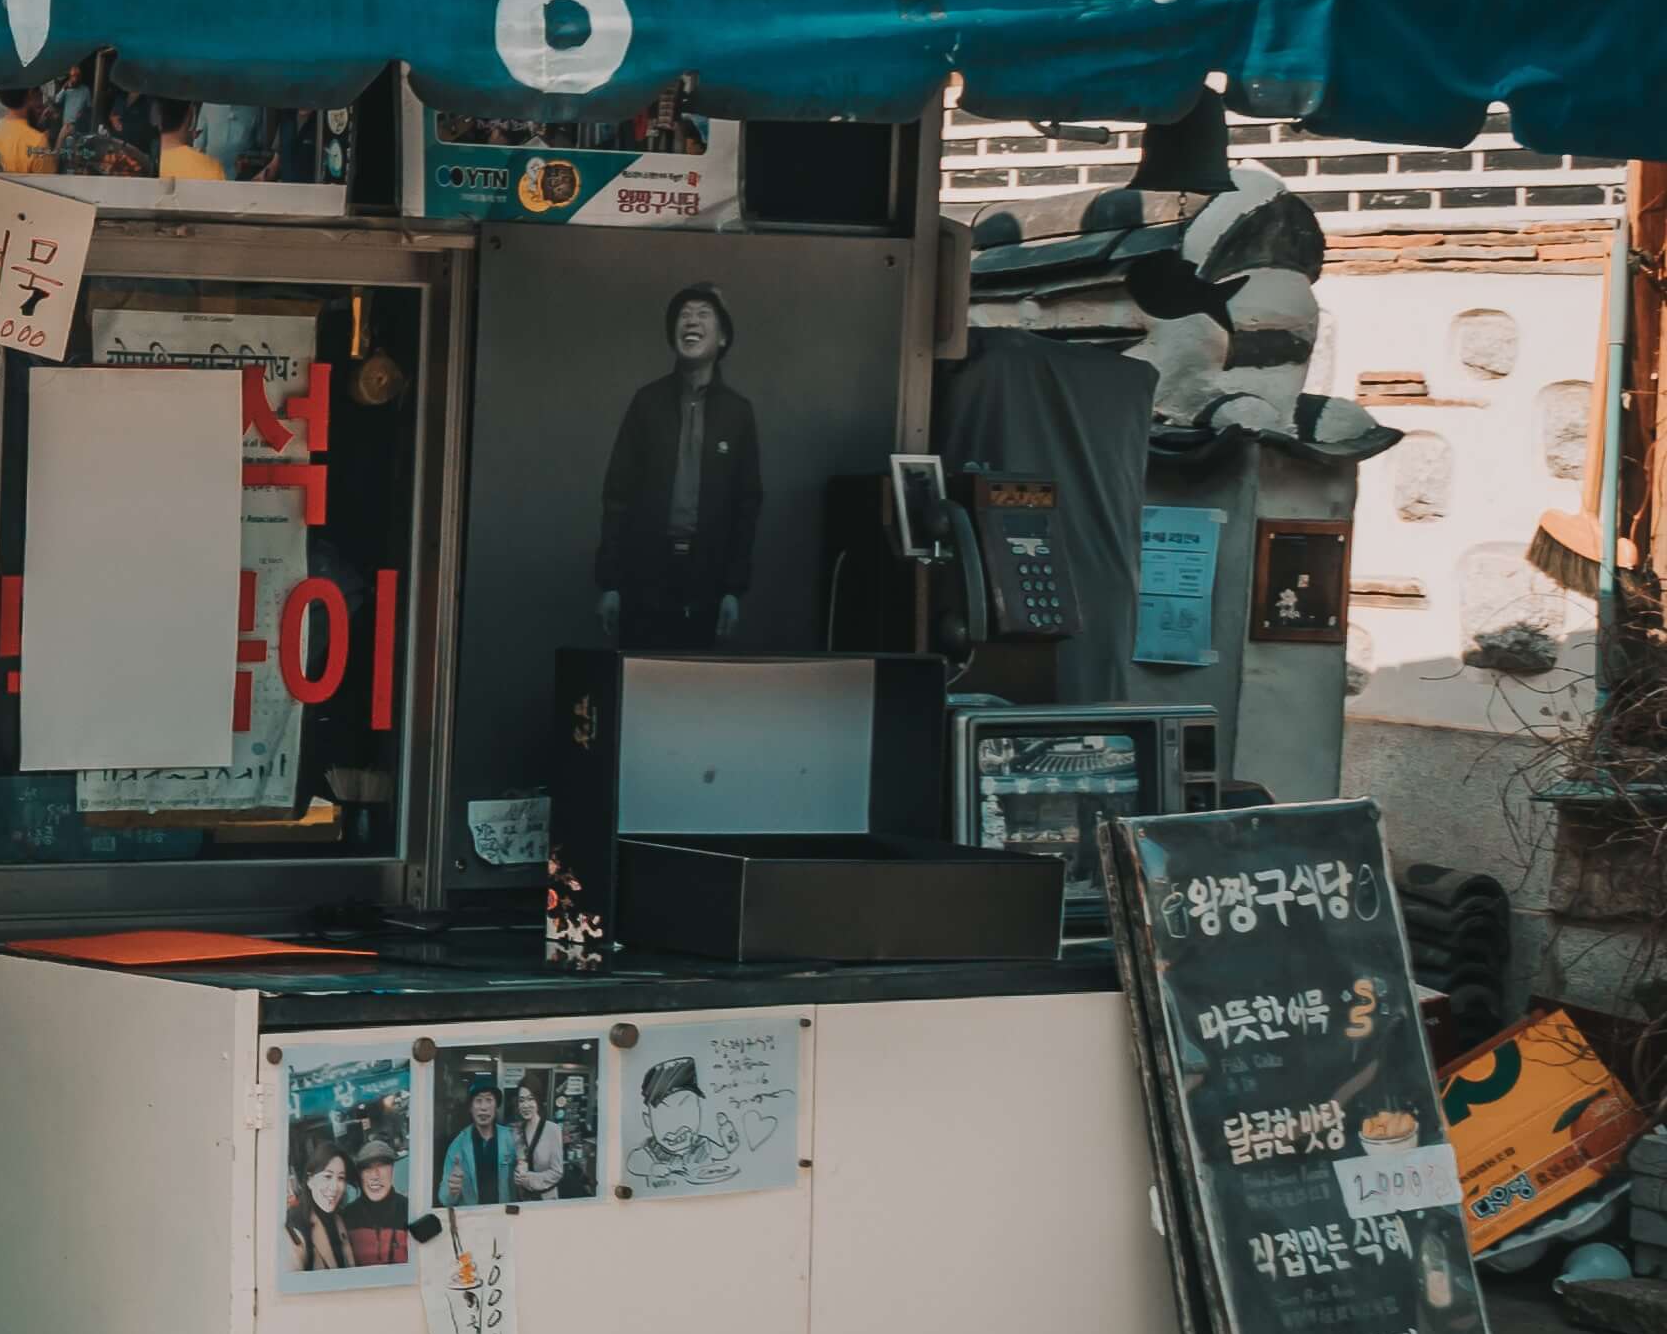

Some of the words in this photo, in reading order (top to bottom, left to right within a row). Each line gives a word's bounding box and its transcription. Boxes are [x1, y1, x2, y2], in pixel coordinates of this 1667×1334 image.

[466, 167, 509, 189] YTN
[617, 188, 701, 217] 왕짱구식당
[1187, 860, 1353, 937] 왕짱구식당
[1198, 995, 1291, 1050] 따뜻한
[1223, 1106, 1298, 1165] 달콤한
[1298, 1099, 1347, 1154] 맛탕
[1353, 1214, 1414, 1266] 식혜
